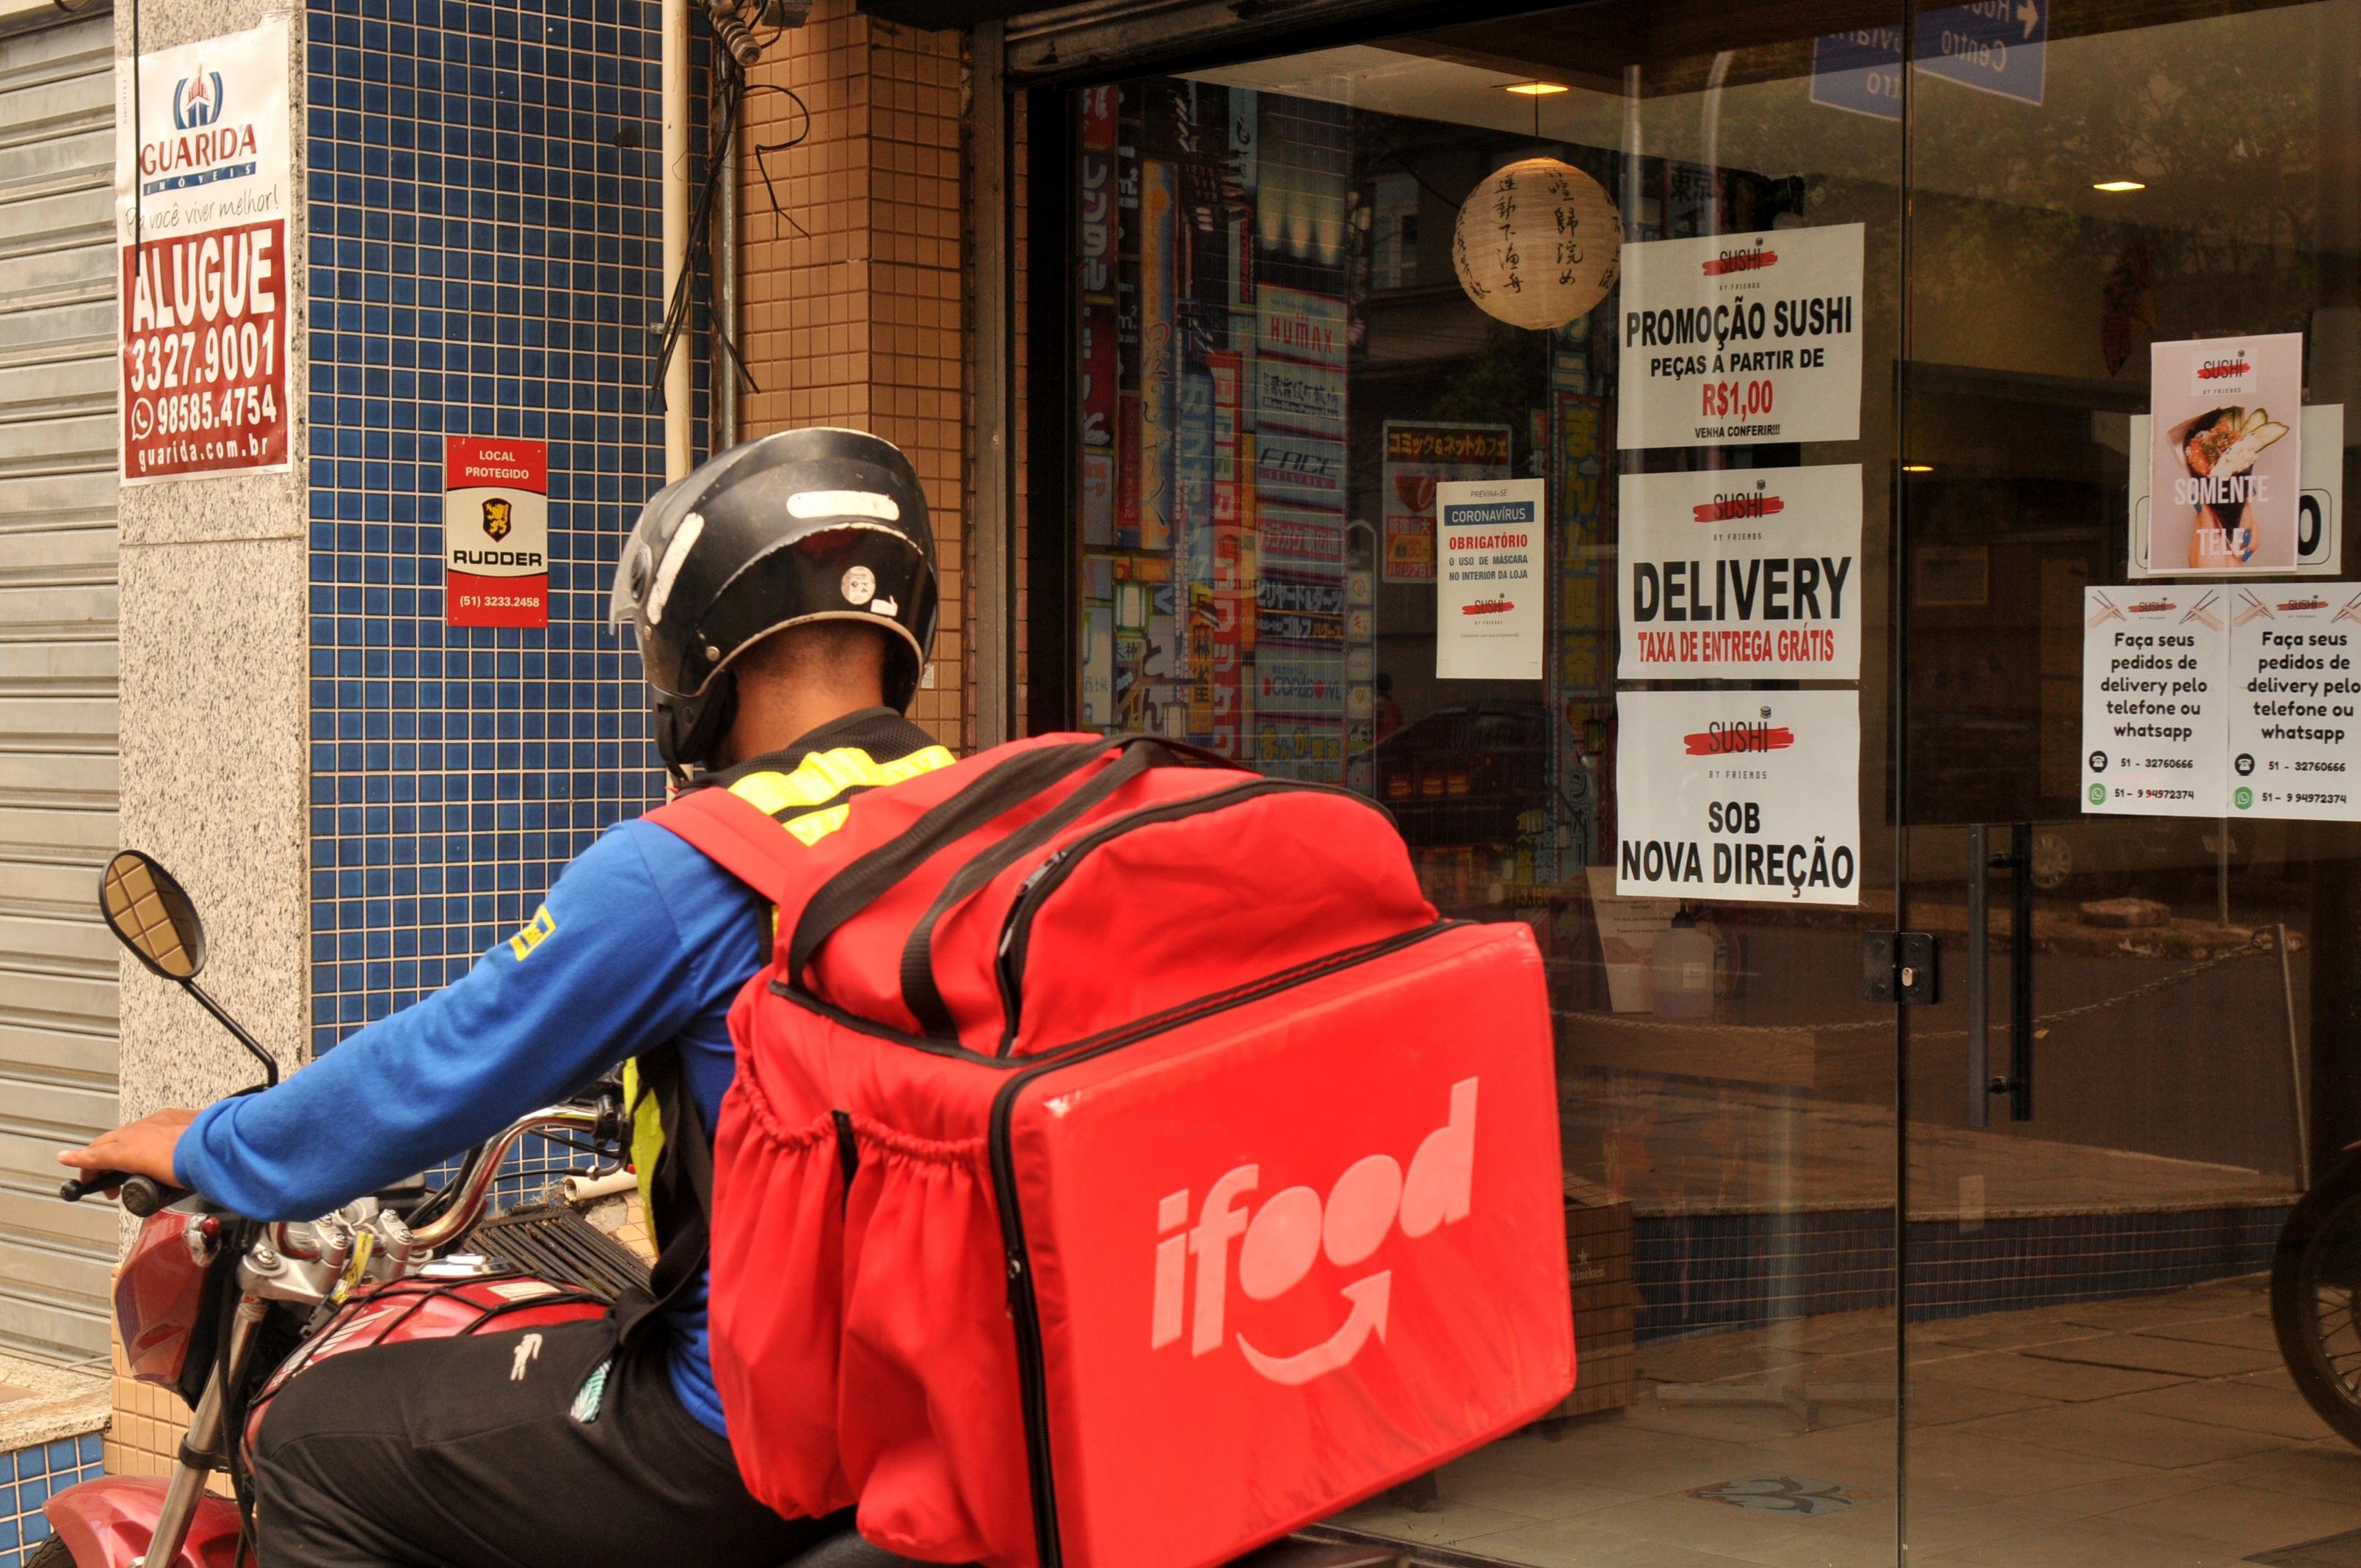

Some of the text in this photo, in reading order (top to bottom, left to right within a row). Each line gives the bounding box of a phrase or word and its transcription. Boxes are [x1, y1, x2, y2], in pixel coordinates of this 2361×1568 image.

[140, 123, 257, 175] GUARIDA
[146, 164, 251, 195] IMÓVEIS
[126, 184, 279, 236] Pa você viver melhor!
[1719, 246, 1762, 274] SUSHI
[132, 228, 275, 333] ALUGUE
[1719, 281, 1760, 291] BY FRIENDS
[1626, 296, 1852, 351] PROMOÇÃO SUSHI
[1271, 314, 1332, 354] HUMAX
[131, 319, 275, 392] 3327.9001
[1650, 348, 1825, 380] PEÇAS A PARTIR DE
[2203, 359, 2243, 380] SUSHI
[157, 384, 277, 435] 98585.4754
[1702, 380, 1774, 421] R$1,00
[1694, 424, 1780, 438] VENHA CONFERIR!!!
[139, 433, 268, 473] guarida.com.br
[479, 449, 516, 462] LOCAL
[465, 467, 529, 479] PROTEGIDO
[1470, 489, 1509, 498] PREVINA-SE
[2174, 475, 2270, 506] SOMENTE
[1451, 506, 1526, 523] CORONAVÍRUS
[1713, 491, 1763, 519] SUSHI
[1448, 531, 1528, 550] OBRIGATÓRIO
[1713, 532, 1763, 542] BY FRIENDS
[2197, 528, 2245, 557] TELE
[453, 550, 542, 567] RUDDER
[1449, 553, 1528, 566] O USO DE MÁSCARA
[1449, 568, 1528, 581] NO INTERIOR DA LOJA
[1633, 556, 1852, 623] DELIVERY
[460, 595, 540, 608] (51) 3233.2458
[1474, 599, 1504, 614] SUSHI
[2139, 600, 2166, 612] SUSHI
[2288, 599, 2317, 610] SUSHI
[1637, 622, 1834, 662] TAXA DE ENTREGA GRÁTIS
[2114, 632, 2195, 650] Faça seus
[2262, 631, 2348, 650] Faça seus
[2111, 654, 2198, 674] pedidos de
[2258, 654, 2350, 674] pedidos de
[2100, 677, 2208, 697] delivery pelo
[2247, 677, 2361, 697] delivery pelo
[2106, 700, 2201, 716] telefone ou
[2253, 700, 2354, 716] telefone ou
[1708, 720, 1769, 755] SUSHI
[2114, 722, 2193, 741] whatsapp
[2261, 724, 2346, 744] whatsapp
[2121, 758, 2130, 767] 51
[2145, 758, 2194, 769] 32760666
[2268, 761, 2279, 770] 51
[2294, 762, 2346, 772] 32760666
[1709, 770, 1767, 780] BY FRIENDS
[2137, 789, 2144, 798] 9
[2145, 789, 2194, 799] 94972374
[2286, 793, 2293, 802] 9
[2295, 793, 2347, 804] 94972374
[1708, 800, 1760, 834] SOB
[1622, 835, 1854, 898] NOVA DIREÇÃO
[1151, 1075, 1479, 1358] ifood
[1570, 1267, 1605, 1282] eineken
